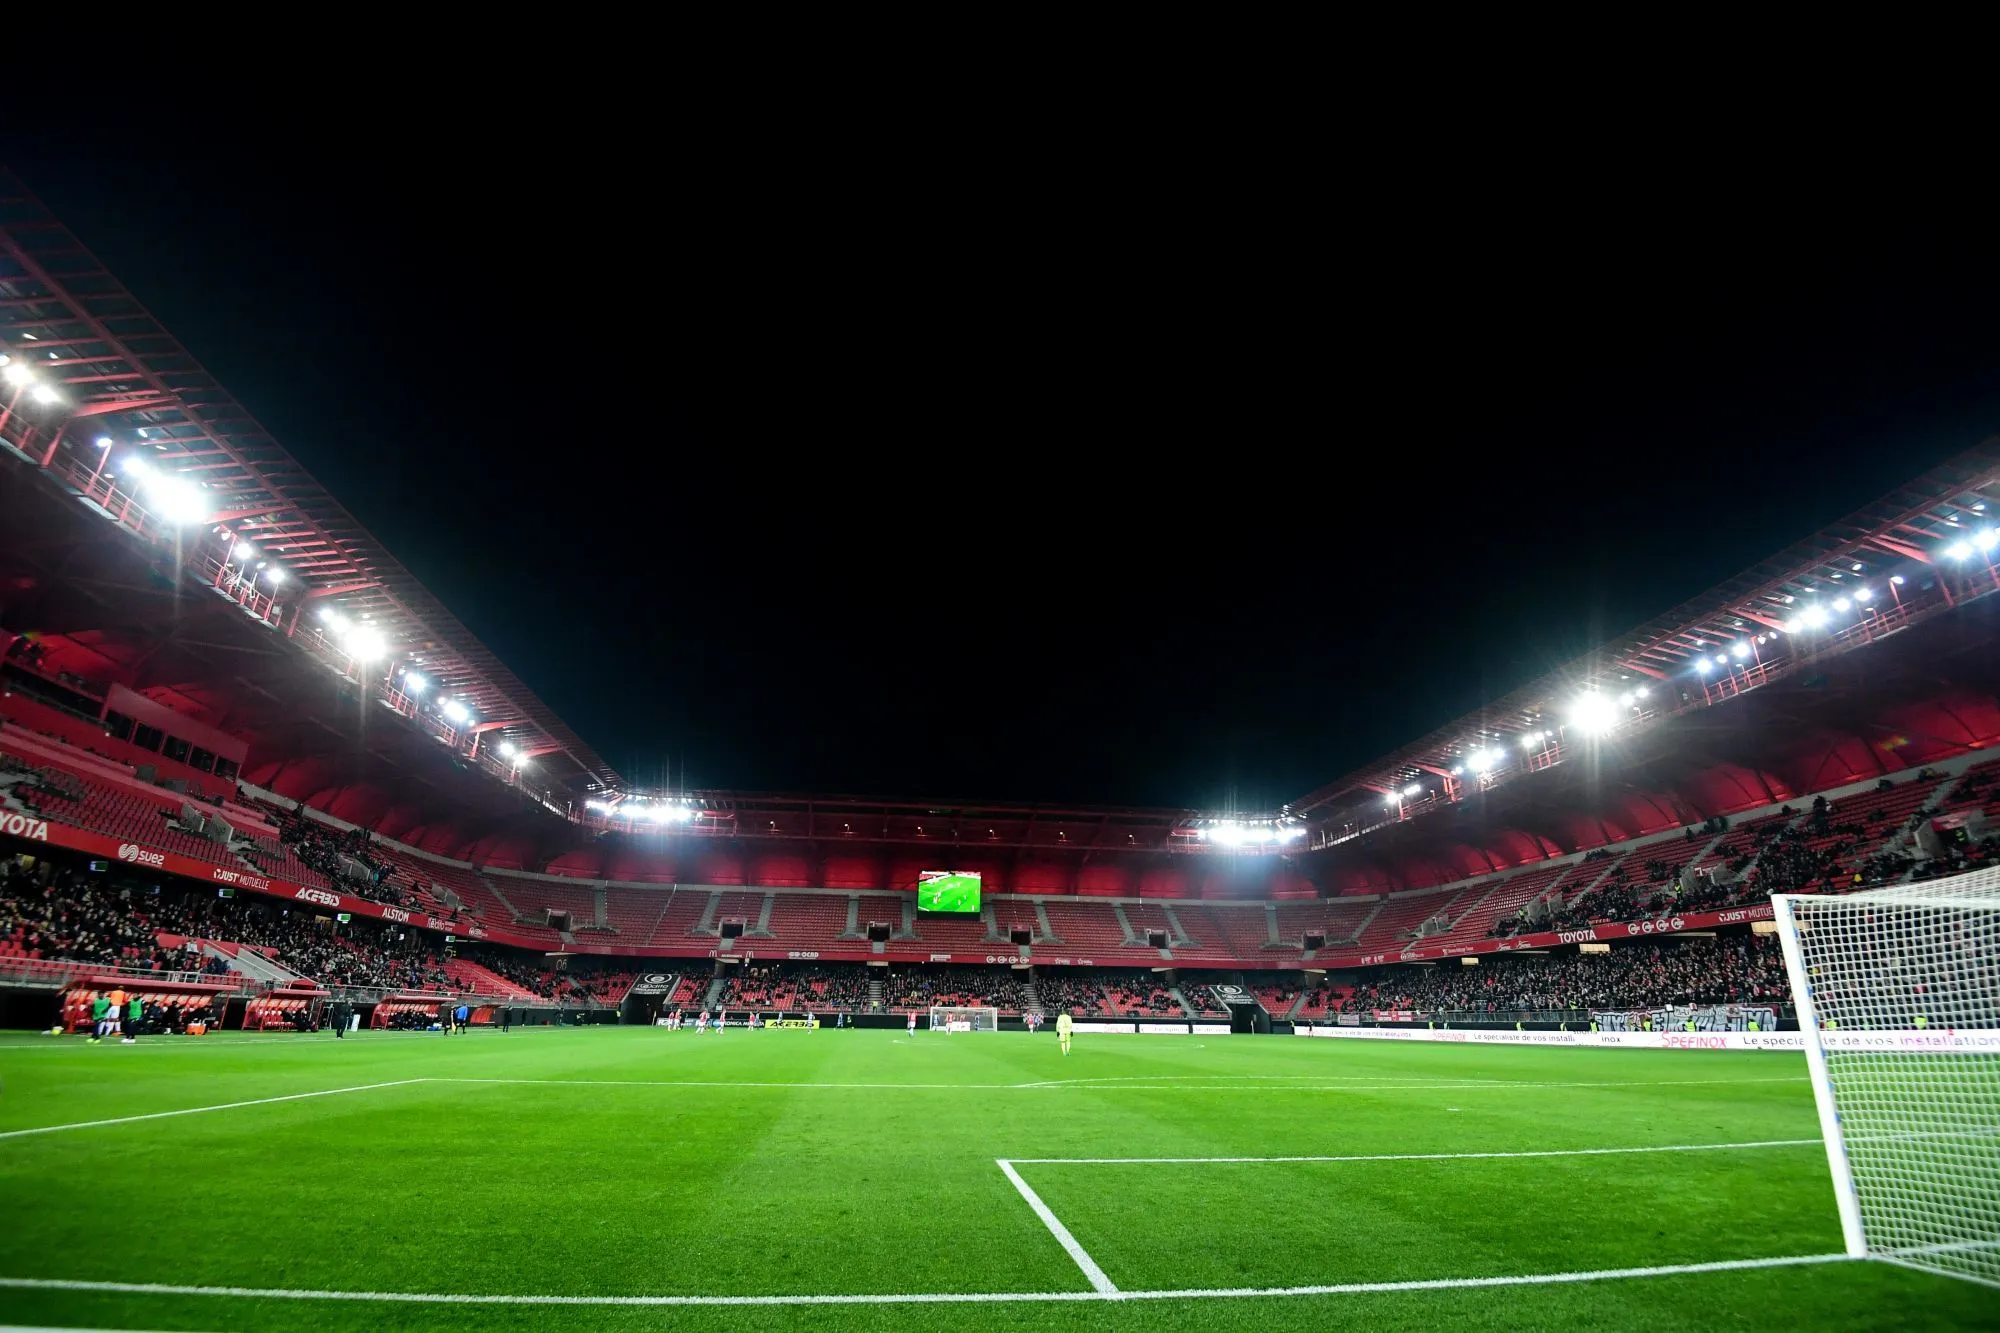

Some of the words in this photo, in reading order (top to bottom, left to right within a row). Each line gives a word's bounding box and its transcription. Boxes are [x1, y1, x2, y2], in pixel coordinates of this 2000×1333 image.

[239, 875, 270, 891] MUTUELLE
[295, 887, 340, 907] ACERBIS
[382, 907, 409, 923] ALSTOM
[1558, 930, 1597, 944] TOYOTA
[1601, 1035, 1621, 1044] inox
[1743, 1036, 1758, 1046] Le
[1842, 1036, 1860, 1046] de
[1865, 1037, 1894, 1047] vos
